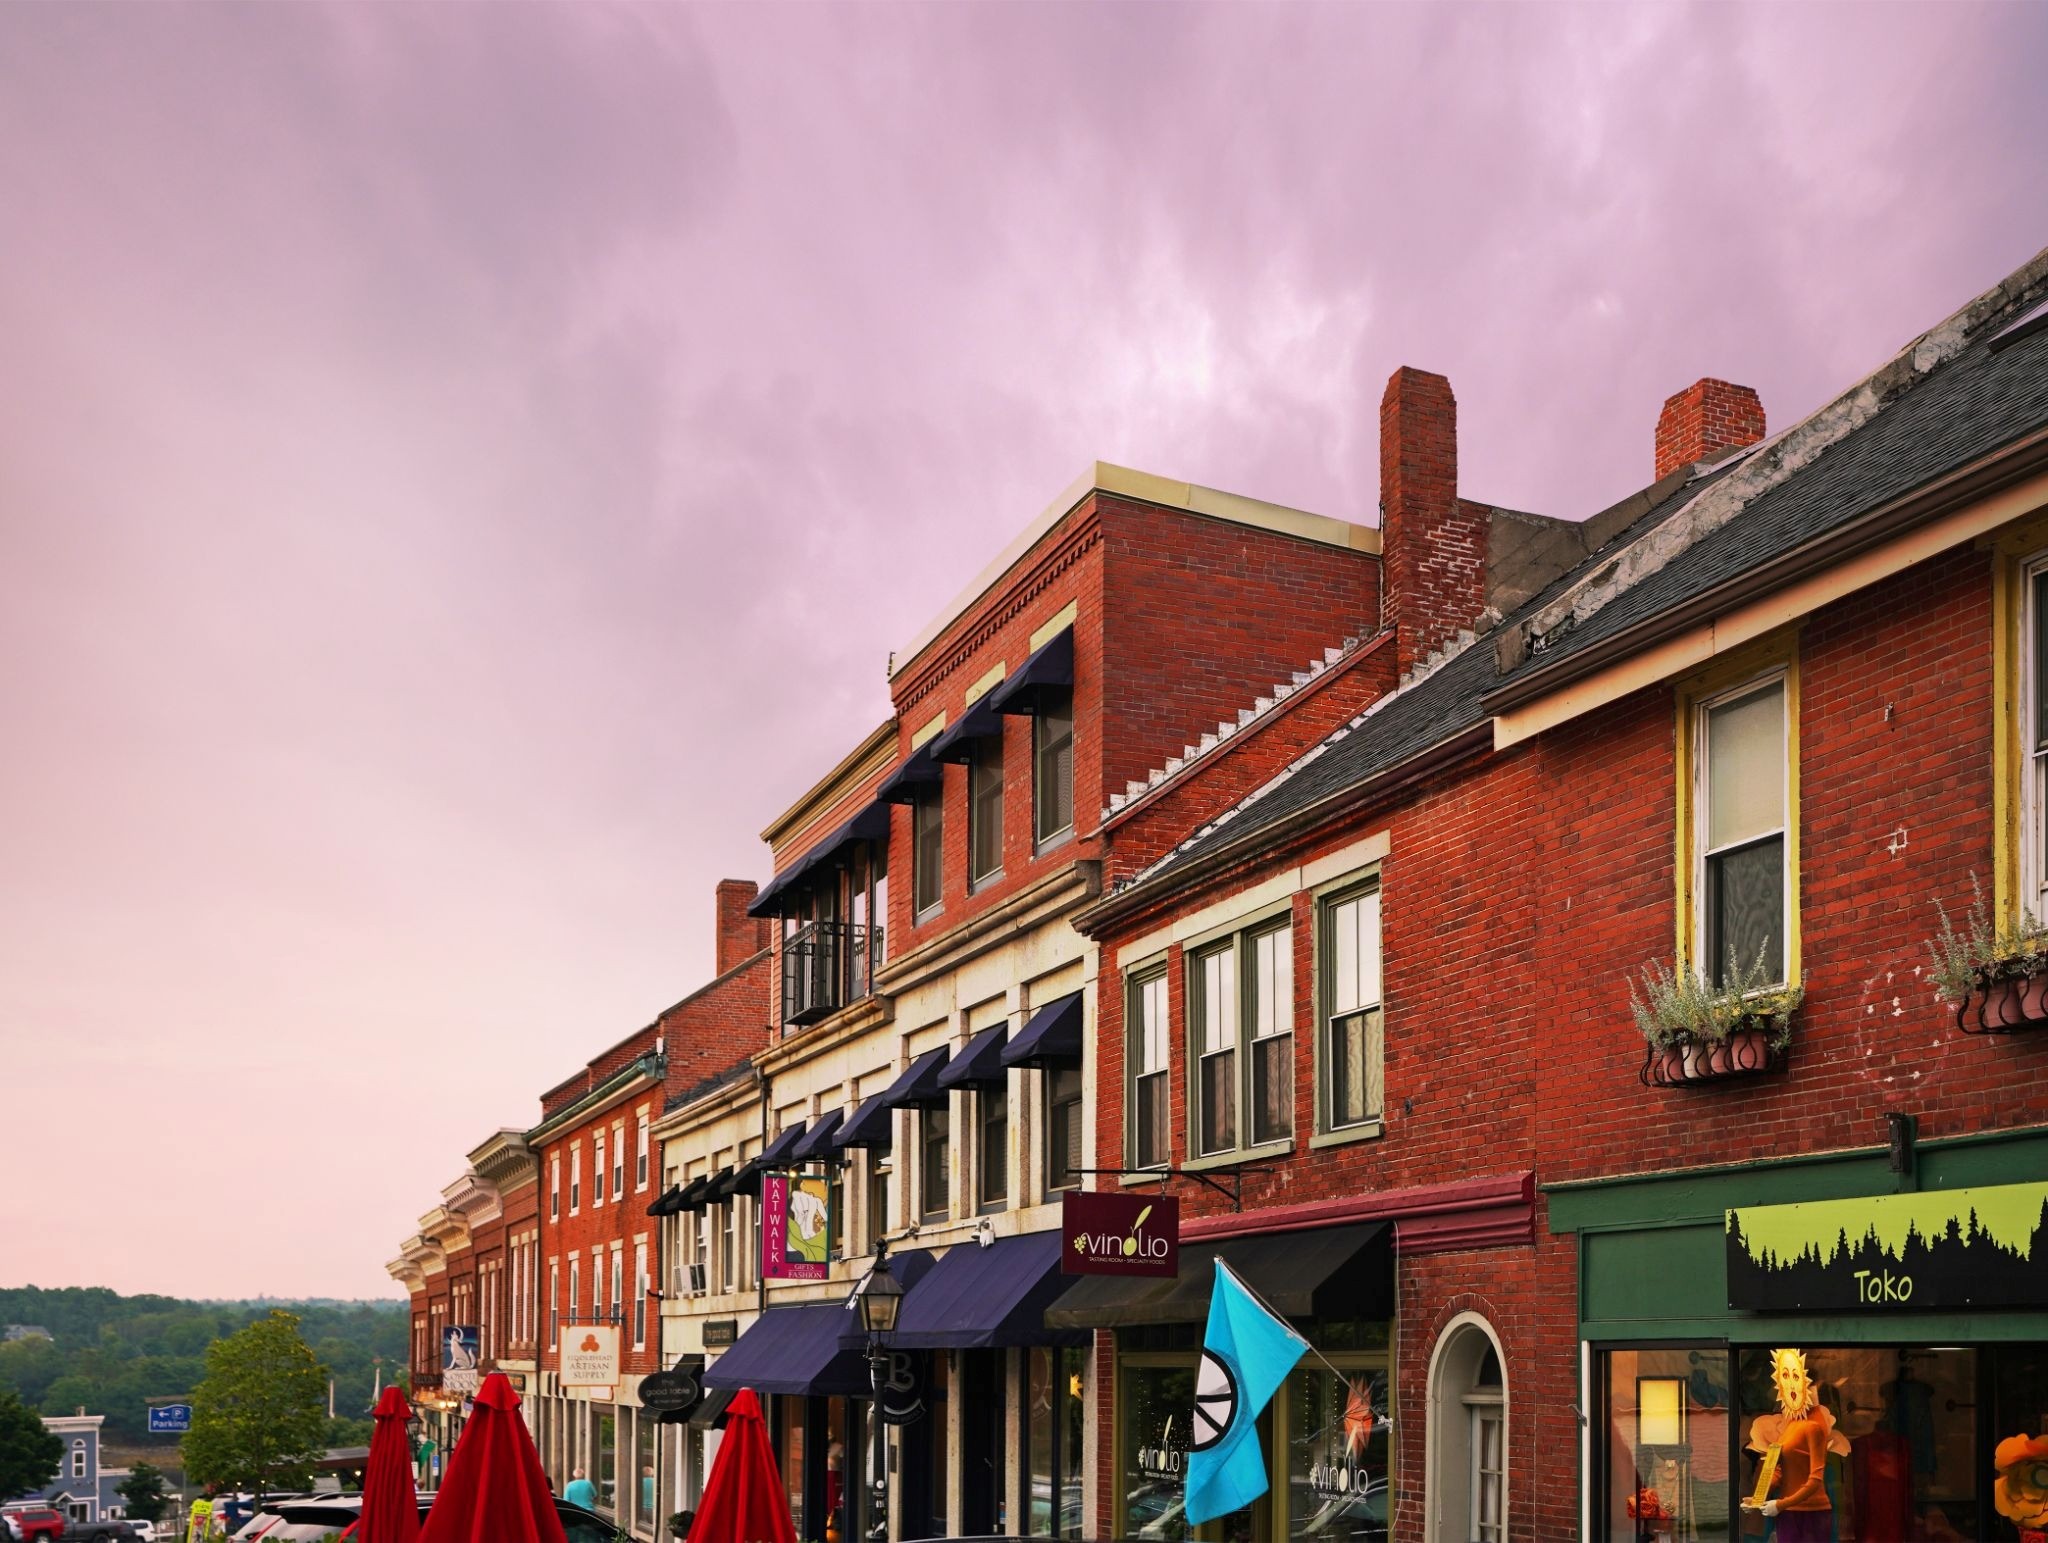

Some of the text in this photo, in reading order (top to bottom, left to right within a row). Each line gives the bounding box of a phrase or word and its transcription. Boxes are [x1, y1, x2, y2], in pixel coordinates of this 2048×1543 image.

[769, 1177, 781, 1263] KATWALK
[794, 1263, 815, 1271] GIFTS
[788, 1271, 823, 1279] FASHION
[1853, 1268, 1913, 1303] Toko
[570, 1362, 609, 1370] ARTISAN
[573, 1371, 607, 1379] SUPPLY
[444, 1380, 477, 1390] MOON
[646, 1387, 691, 1397] good table
[153, 1421, 188, 1430] Parking
